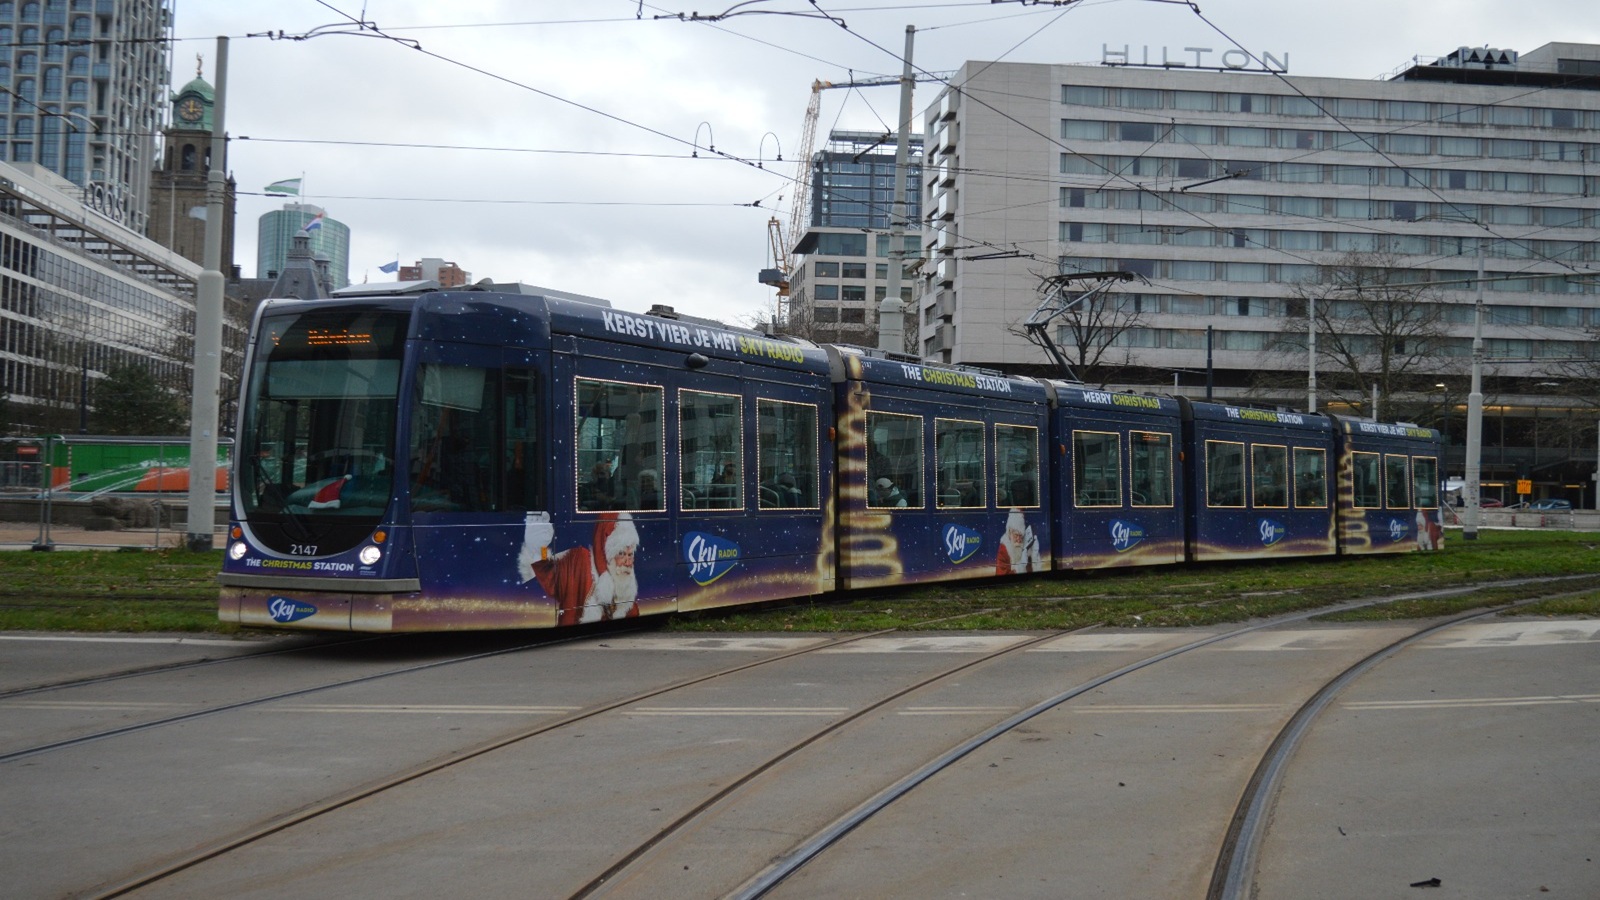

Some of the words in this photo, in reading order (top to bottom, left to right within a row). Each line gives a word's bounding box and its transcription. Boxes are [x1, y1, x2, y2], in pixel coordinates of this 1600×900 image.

[1102, 43, 1289, 72] HILTON
[602, 311, 655, 340] KERST
[655, 321, 692, 345] VIER
[693, 328, 711, 347] JE
[710, 330, 738, 352] MET
[738, 335, 766, 356] SKY
[766, 342, 804, 364] RADIO
[901, 364, 922, 381] THE
[922, 368, 977, 389] CHRISTMAS
[976, 375, 1011, 393] STATION
[1083, 390, 1112, 405] MERRY
[1225, 407, 1240, 419] THE
[1239, 409, 1278, 423] CHRISTMAS
[1277, 411, 1304, 425] STATION
[945, 526, 966, 557] Sky
[1112, 521, 1130, 547] Sky
[290, 544, 318, 556] 2147
[688, 534, 718, 577] Sky
[718, 548, 738, 558] RADIO
[246, 558, 261, 567] THE
[262, 559, 313, 570] CHRISTMAS
[313, 562, 354, 571] STATION
[270, 598, 296, 621] Sky
